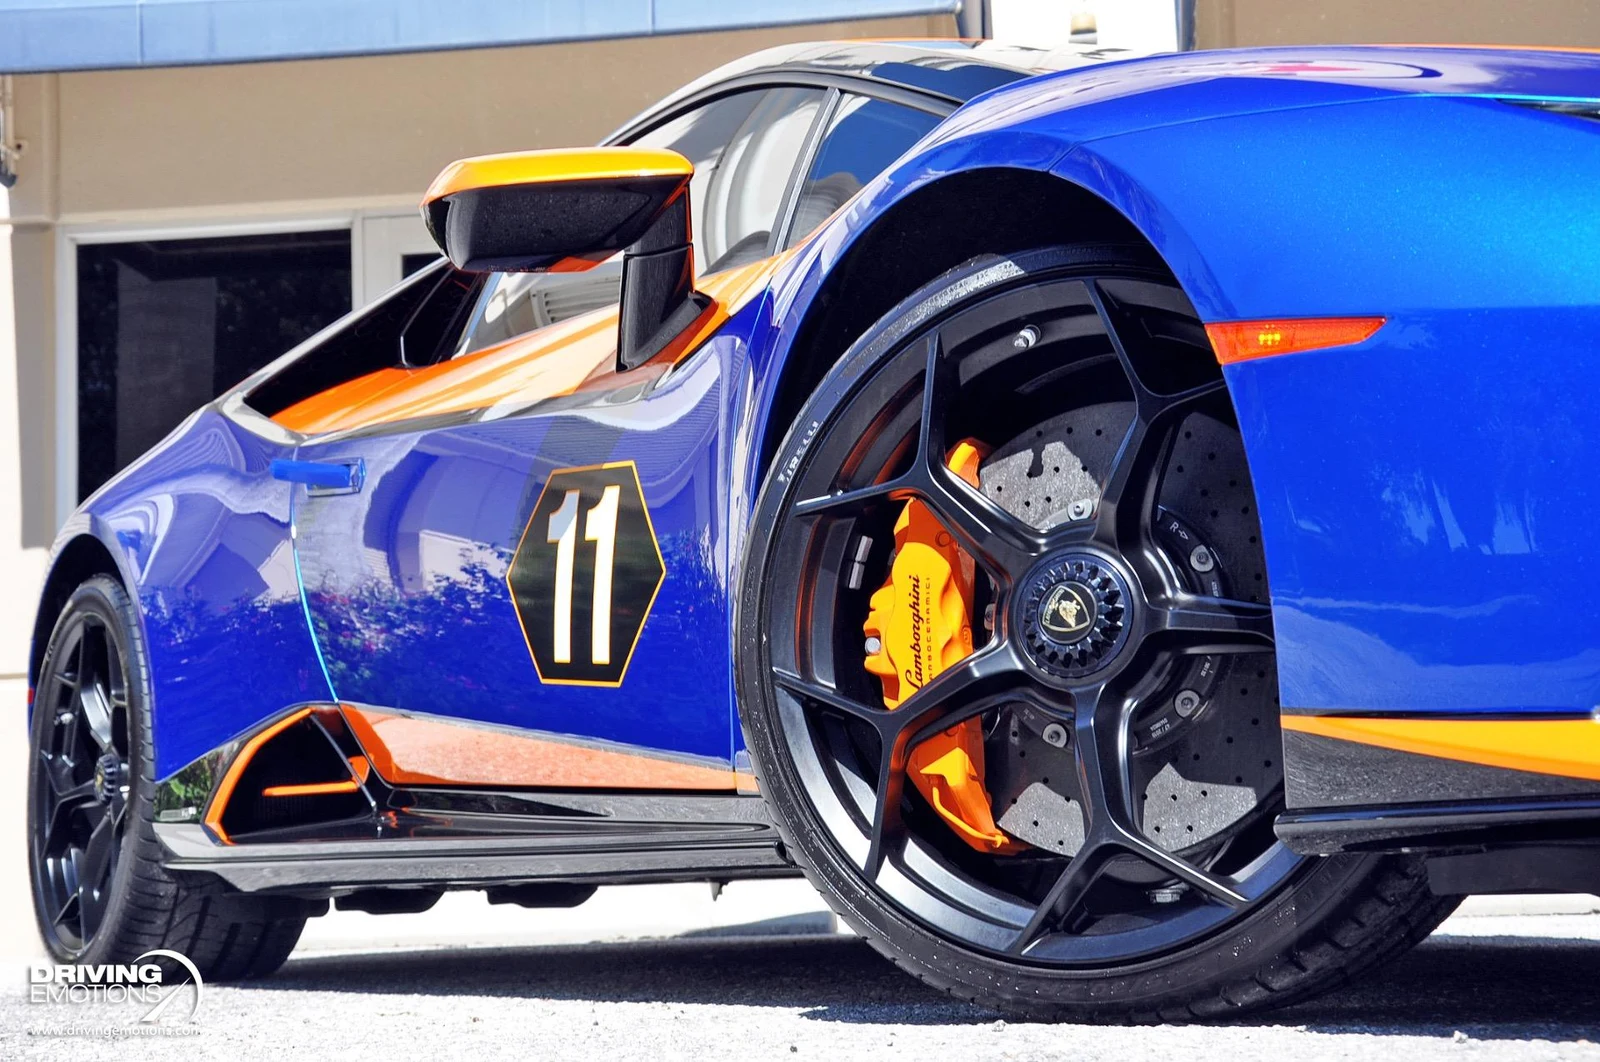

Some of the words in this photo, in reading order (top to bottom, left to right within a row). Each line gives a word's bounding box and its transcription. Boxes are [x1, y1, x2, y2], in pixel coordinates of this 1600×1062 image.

[547, 485, 620, 664] 11
[1169, 521, 1179, 533] R
[905, 575, 924, 690] Lamborghini
[925, 577, 934, 681] ARBOCERAMICI
